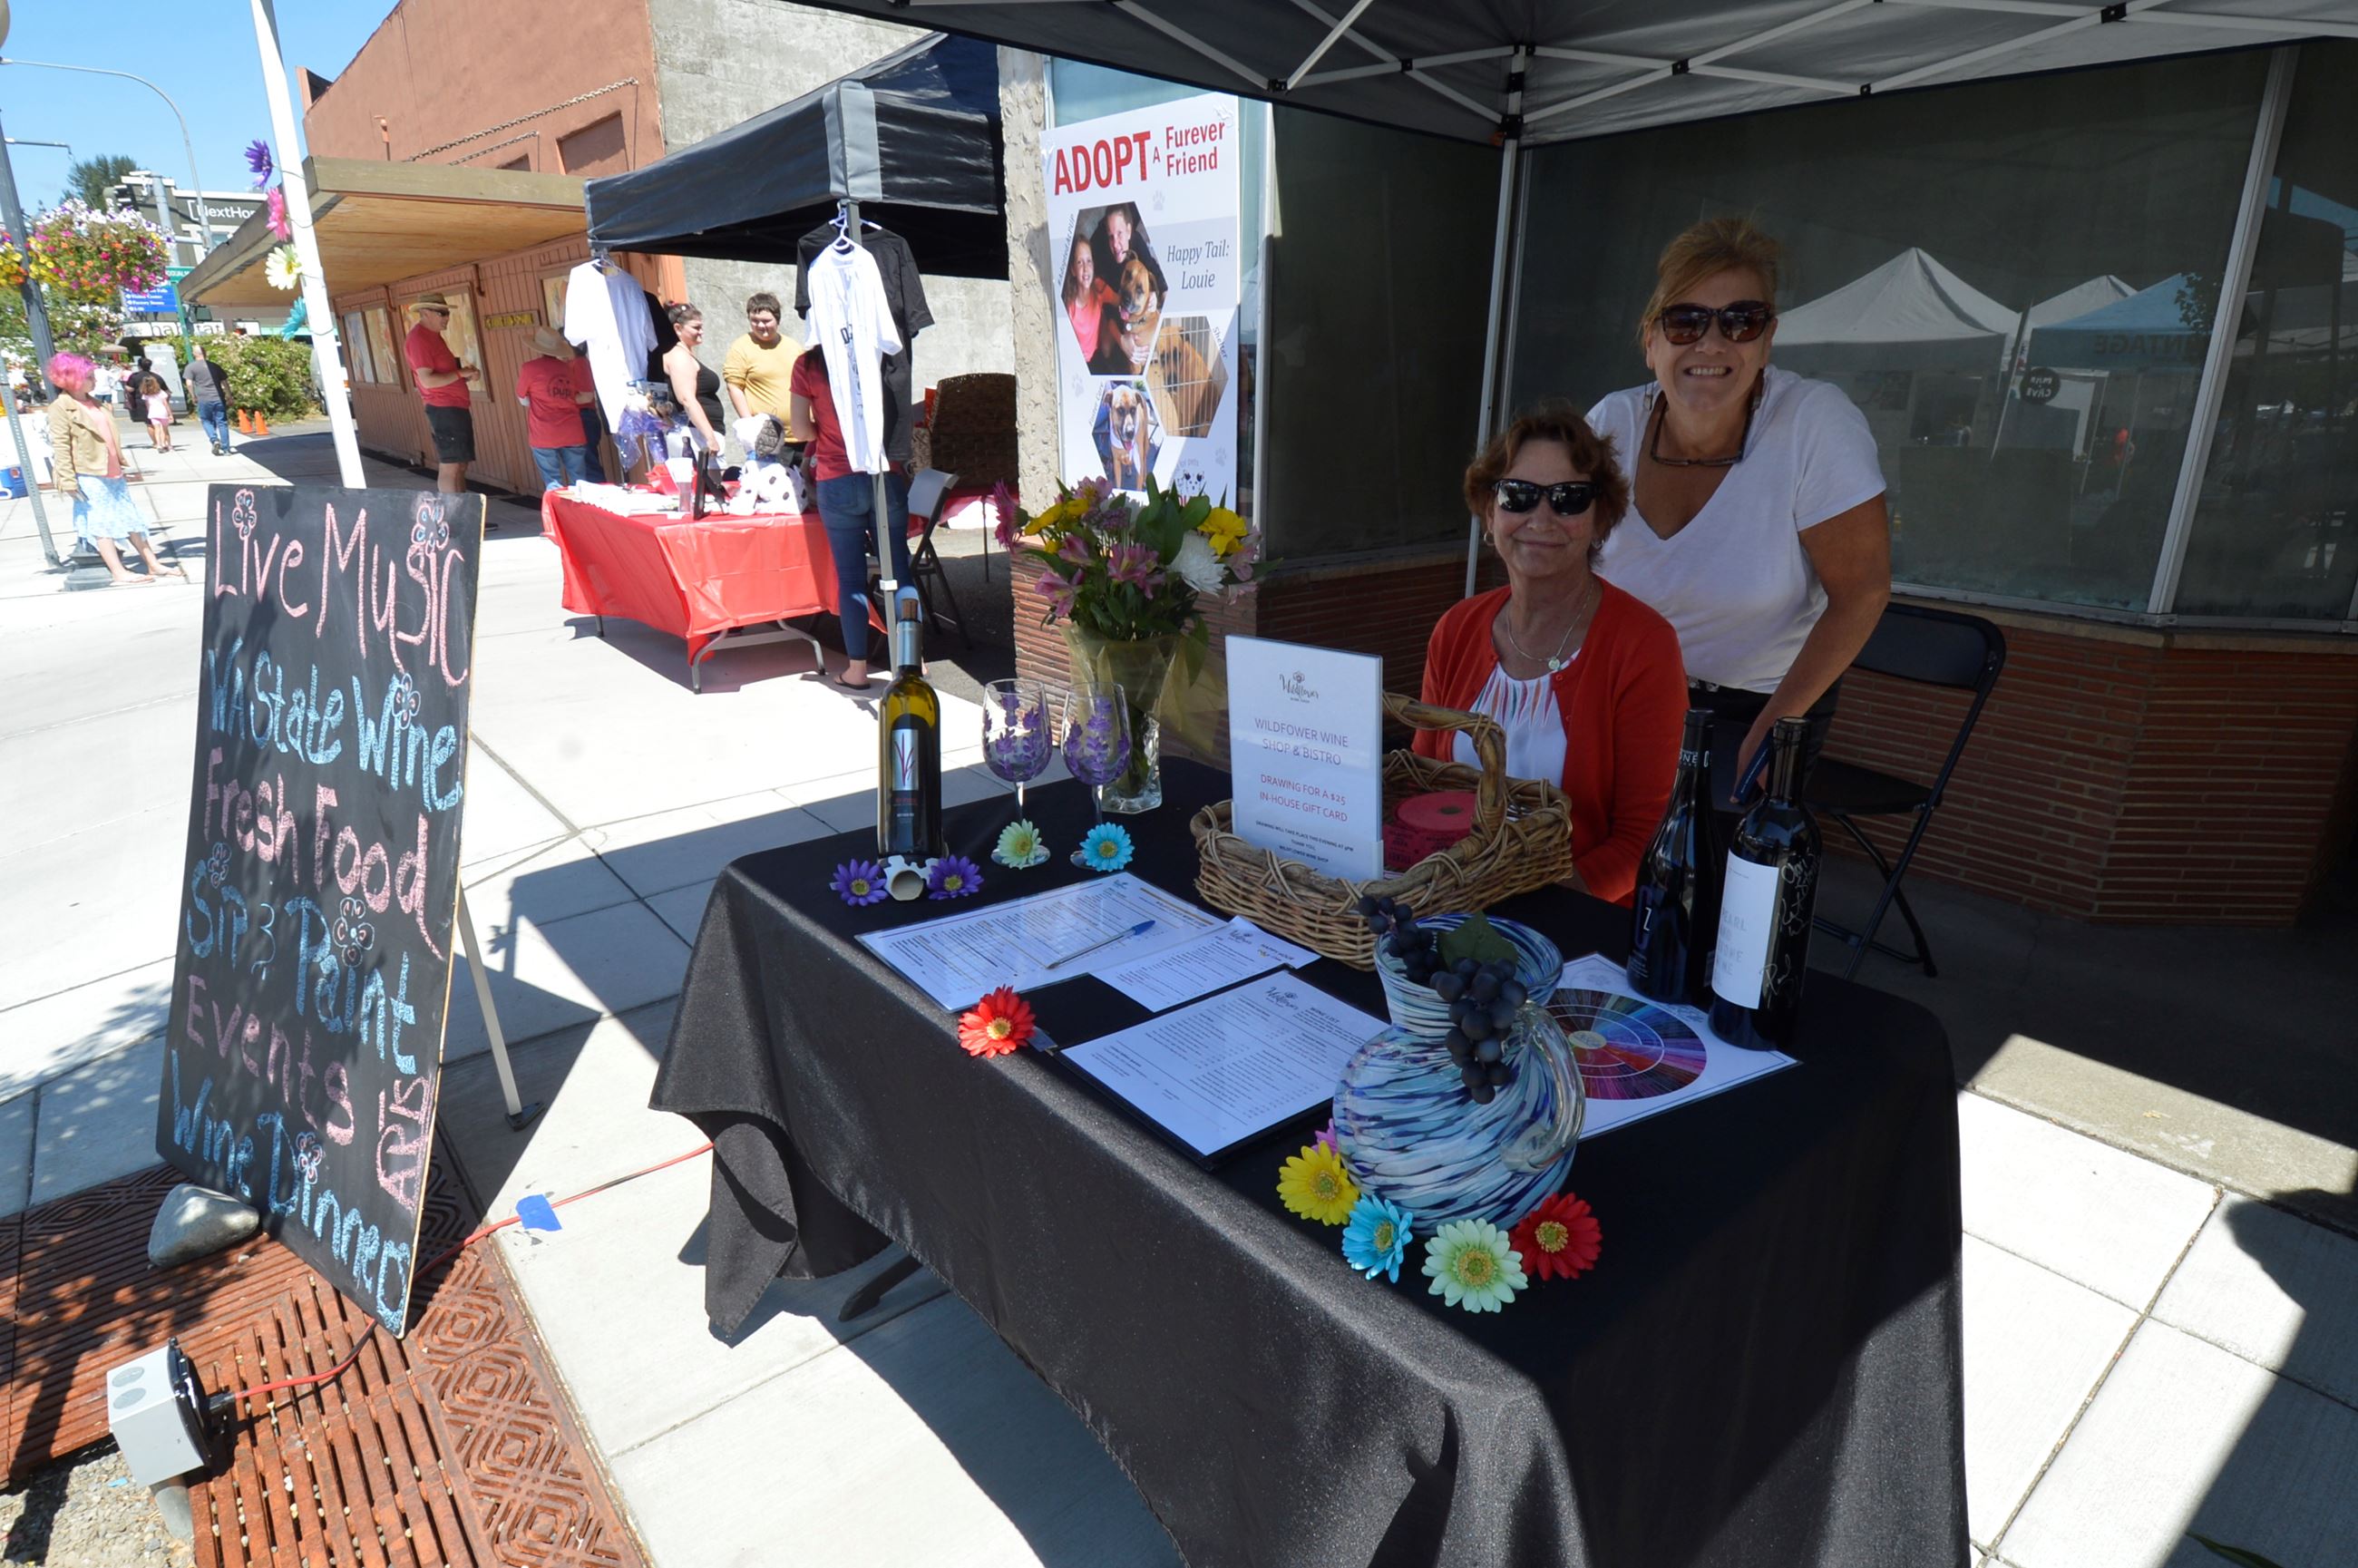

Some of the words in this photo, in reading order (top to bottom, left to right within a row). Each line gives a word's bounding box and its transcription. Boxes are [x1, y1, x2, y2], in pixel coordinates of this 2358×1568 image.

[1165, 122, 1225, 150] Furever
[1054, 131, 1151, 196] ADOPT
[1153, 145, 1161, 164] A
[1166, 146, 1218, 177] Friend
[1167, 244, 1203, 266] Happy
[1204, 239, 1230, 259] Tail:
[1181, 270, 1215, 290] Louie
[1212, 326, 1228, 359] Shelter
[214, 500, 308, 618] Live
[315, 502, 468, 687] Music
[249, 650, 345, 765] State
[352, 669, 463, 813] Wine
[1254, 717, 1318, 741] WILDFOWER
[1320, 730, 1349, 748] WINE
[1262, 738, 1291, 754] SHOP
[1292, 745, 1300, 756] &
[1303, 746, 1341, 765] BISTRO
[1261, 774, 1301, 793] DRAWING
[1302, 784, 1320, 796] FOR
[1322, 790, 1329, 799] A
[1330, 794, 1346, 806] $25
[1260, 791, 1301, 810] IN-HOUSE
[1301, 802, 1321, 815] GIFT
[1322, 807, 1349, 822] CARD
[204, 746, 300, 886] Fresh
[314, 784, 444, 959] Food
[284, 895, 417, 1075] Paint
[187, 974, 355, 1146] Events
